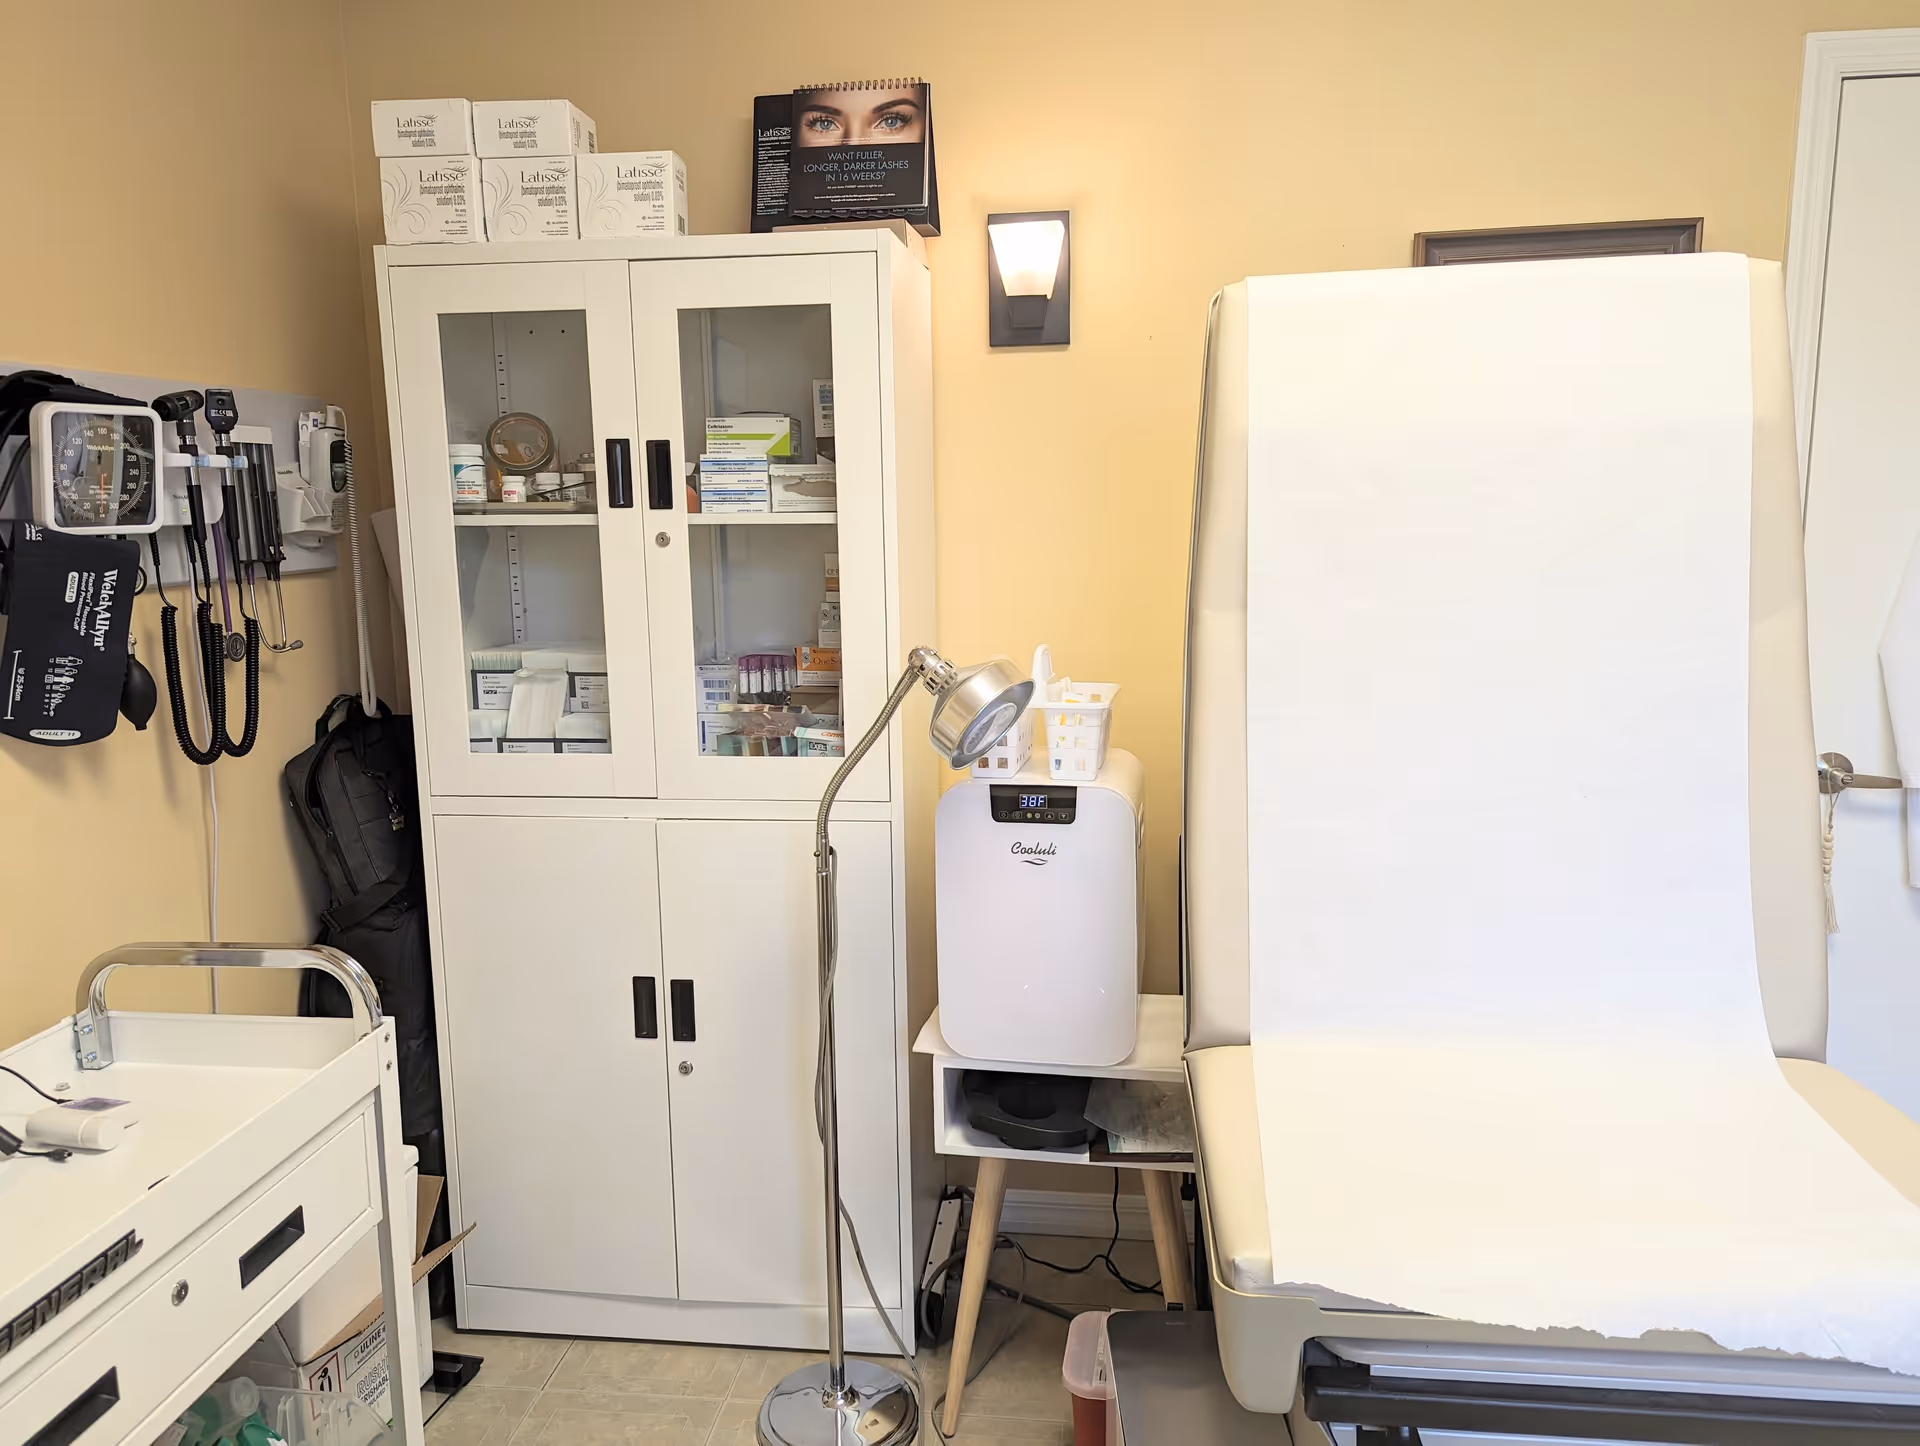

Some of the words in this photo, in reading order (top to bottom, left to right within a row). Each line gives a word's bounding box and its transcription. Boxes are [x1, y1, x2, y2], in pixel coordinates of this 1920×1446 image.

[827, 152, 855, 160] WANT
[856, 151, 885, 160] FULLER,
[616, 166, 666, 178] Latisse
[804, 163, 841, 173] LONGER,
[843, 162, 876, 171] DARKER
[877, 160, 909, 170] LASHES
[419, 169, 467, 182] Latisse
[520, 170, 568, 183] Latisse
[825, 174, 835, 182] IN
[839, 173, 849, 181] 16
[851, 172, 886, 181] WEEKS?
[97, 427, 108, 435] 160
[72, 437, 82, 445] 120
[127, 454, 137, 462] 220
[60, 463, 68, 471] 80
[129, 468, 140, 476] 240
[68, 574, 77, 594] ADULT
[80, 571, 89, 591] Blood
[75, 591, 86, 617] Pressure
[73, 617, 81, 631] Cuff
[80, 605, 91, 637] Reusable
[1021, 795, 1045, 807] 38F
[1010, 841, 1057, 855] Cooluli
[360, 1328, 382, 1353] ULINE
